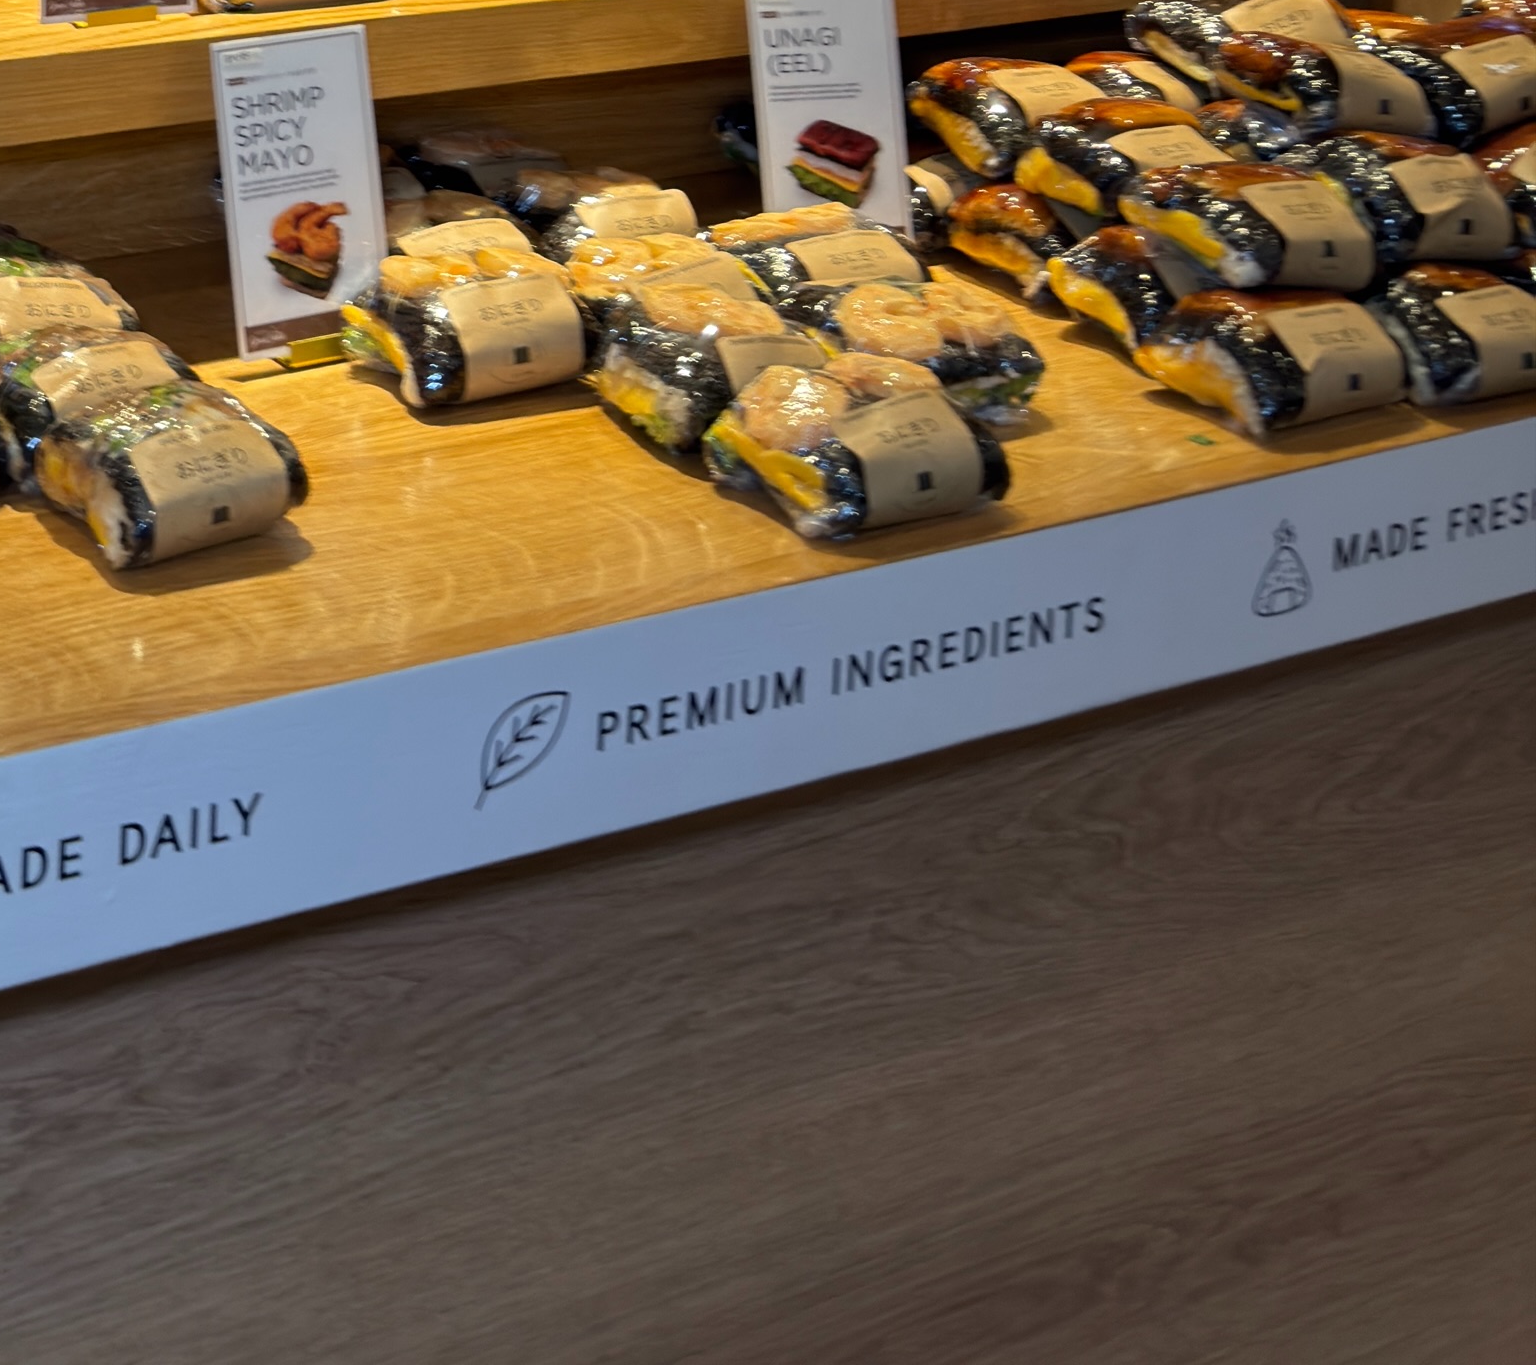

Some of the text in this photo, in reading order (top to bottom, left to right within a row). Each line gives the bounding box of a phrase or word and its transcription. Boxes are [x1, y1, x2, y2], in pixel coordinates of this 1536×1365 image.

[764, 27, 841, 48] UNAGI
[766, 53, 831, 76] (EEL)
[231, 86, 325, 118] SHRIMP
[234, 116, 307, 147] SPICY
[237, 144, 314, 176] MAYO
[1332, 517, 1429, 572] MADE
[594, 597, 1107, 752] PREMIUM INGREDIENTS
[119, 792, 262, 866] DAILY
